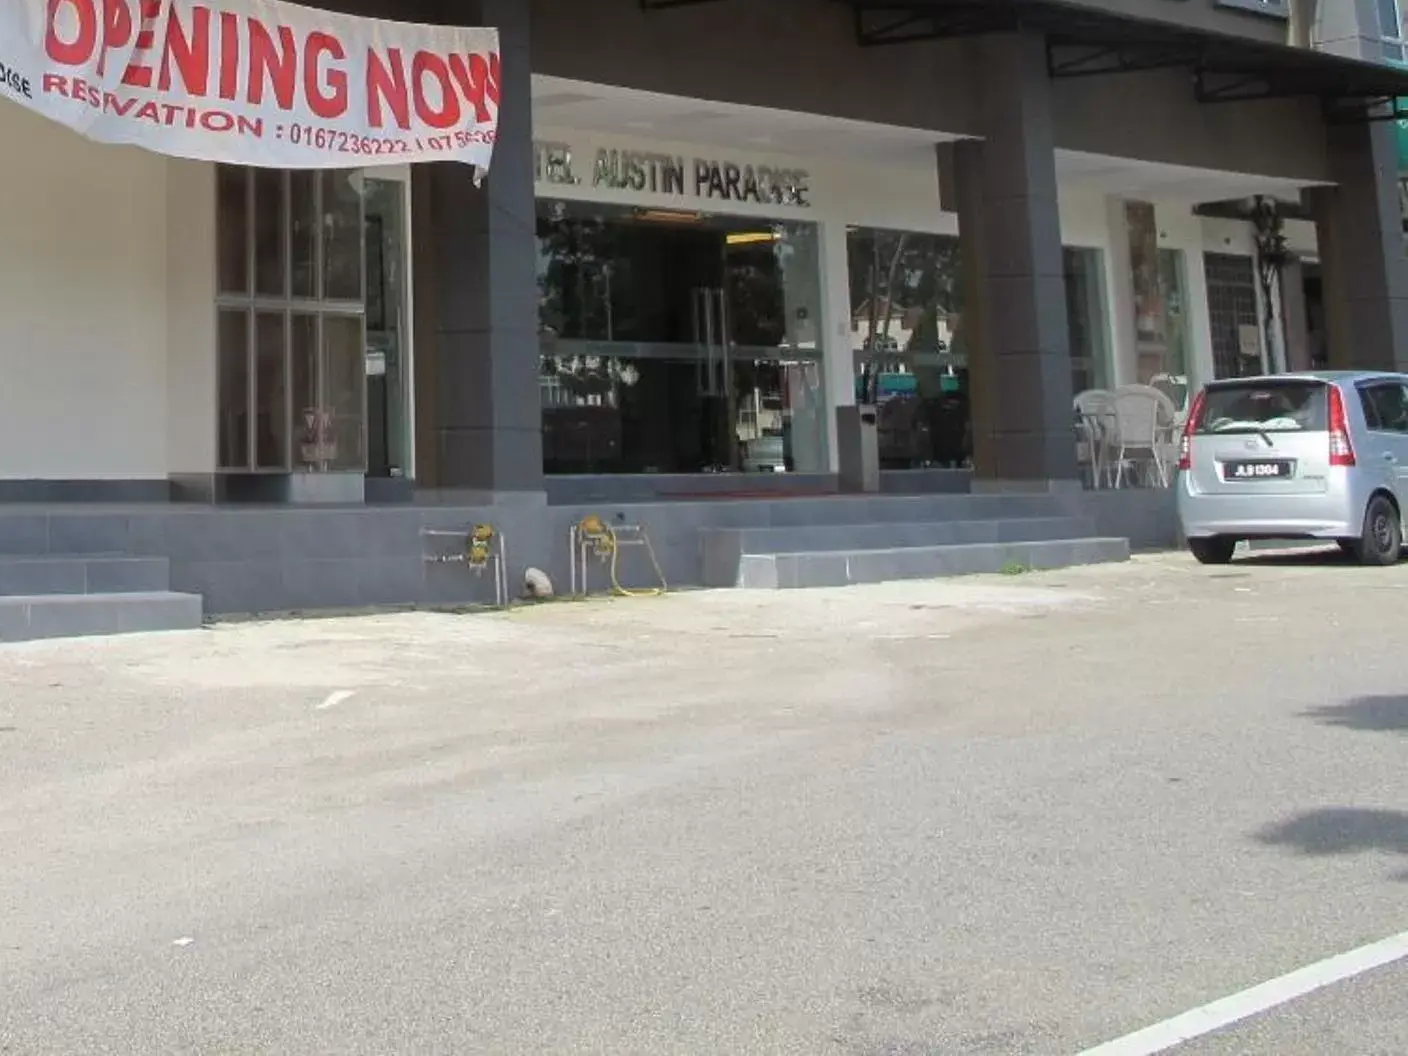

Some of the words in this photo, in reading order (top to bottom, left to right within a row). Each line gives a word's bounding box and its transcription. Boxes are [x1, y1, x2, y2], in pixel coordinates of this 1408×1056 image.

[365, 47, 502, 130] NOW
[593, 147, 685, 195] AUSTIN
[695, 157, 810, 208] PARADISE
